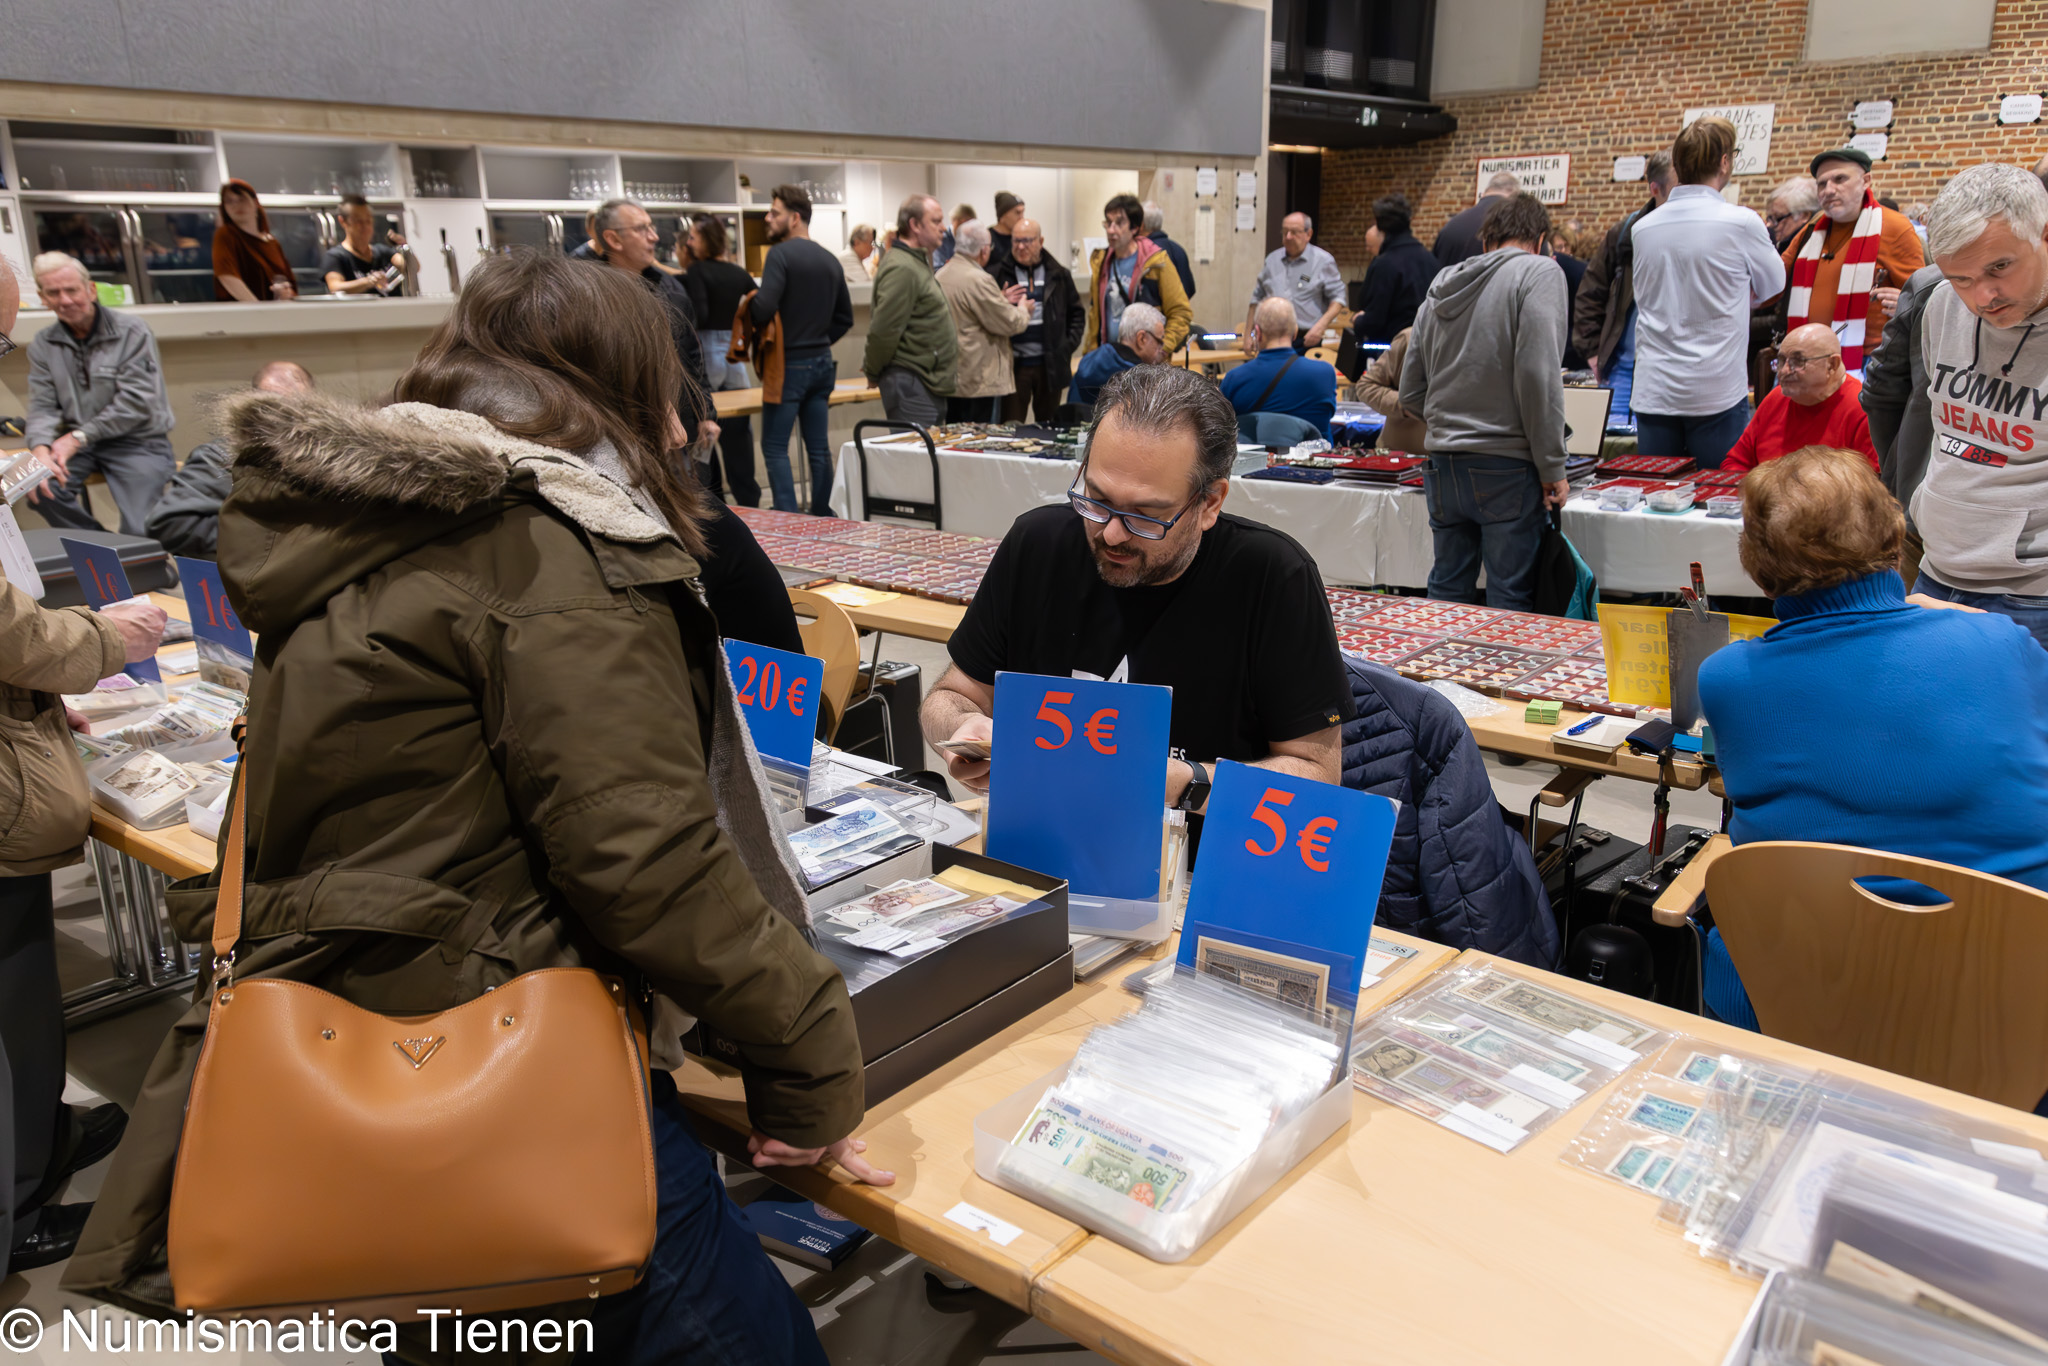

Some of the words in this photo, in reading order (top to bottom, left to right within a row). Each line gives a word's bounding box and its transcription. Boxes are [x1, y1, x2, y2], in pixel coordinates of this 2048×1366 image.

[1933, 362, 2048, 422] TOMMY
[1938, 401, 2035, 453] JEANS
[737, 655, 781, 712] 20
[786, 676, 808, 717] €
[1034, 690, 1075, 751] 5
[1083, 708, 1120, 756] €
[1244, 786, 1296, 857] 5
[1295, 815, 1338, 873] €
[1048, 1127, 1067, 1149] 500
